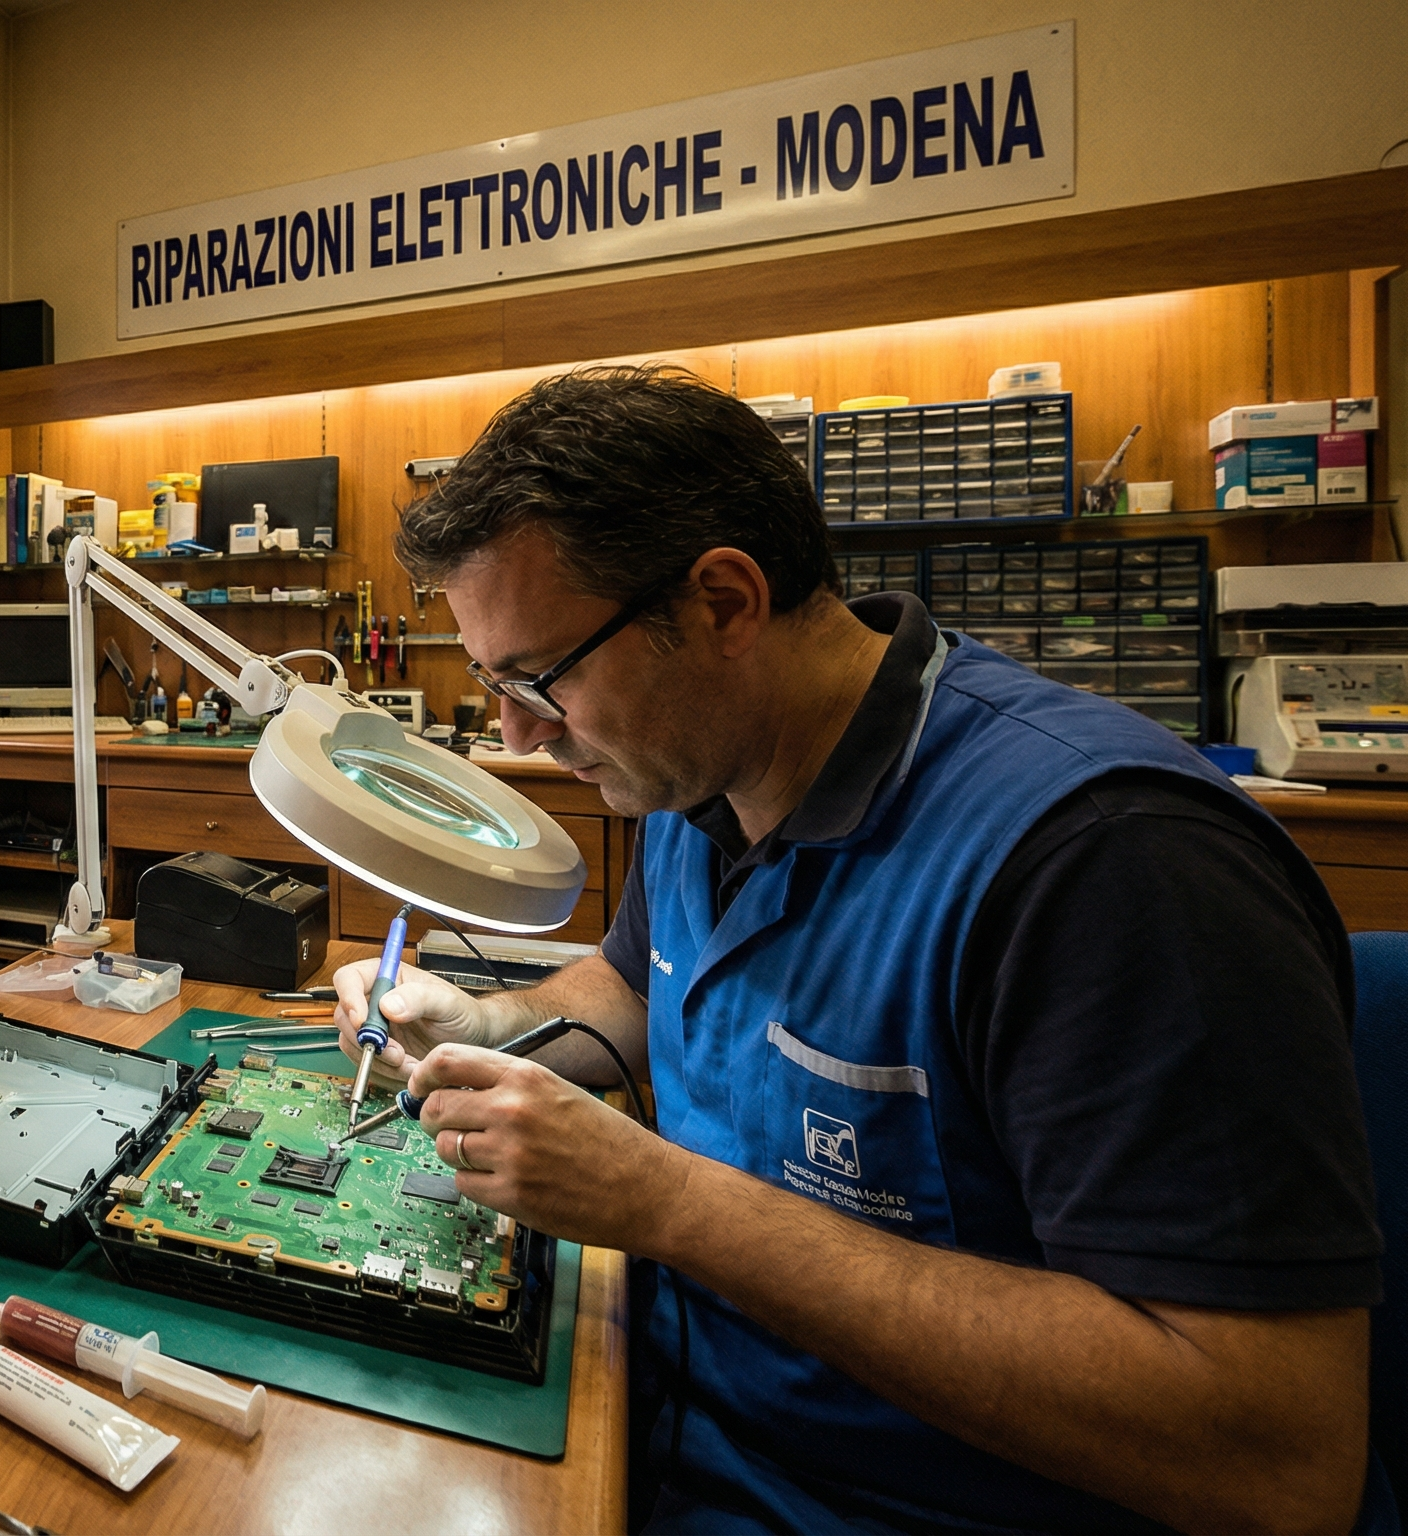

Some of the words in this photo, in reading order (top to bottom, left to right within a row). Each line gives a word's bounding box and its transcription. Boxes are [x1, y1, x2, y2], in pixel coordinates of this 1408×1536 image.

[131, 203, 354, 309] RIPARAZIONI
[370, 130, 722, 268] ELETTRONICHE
[740, 164, 757, 186] -
[776, 70, 1045, 201] MODENA
